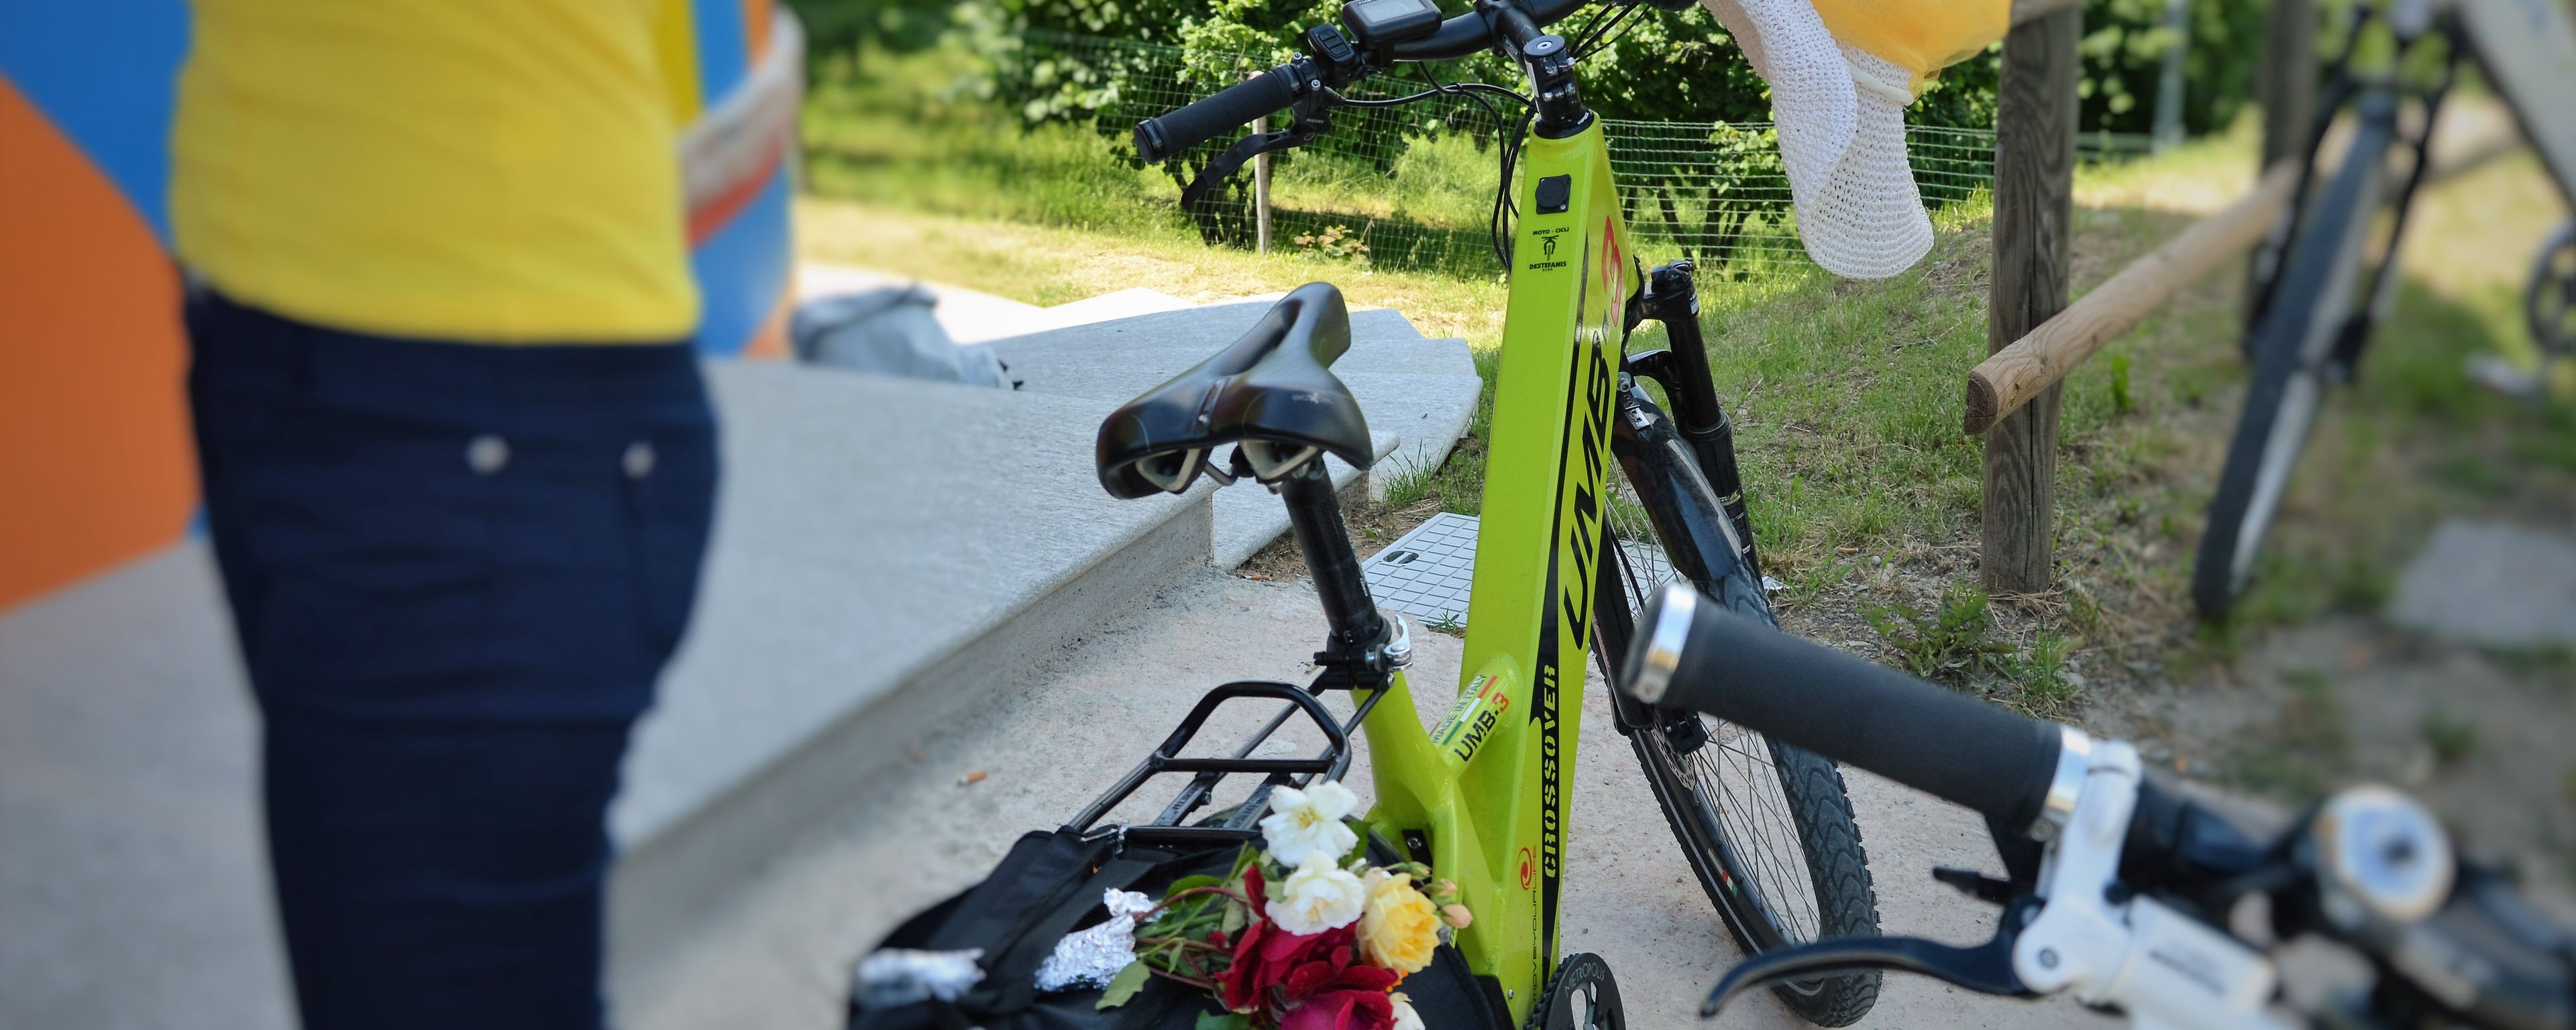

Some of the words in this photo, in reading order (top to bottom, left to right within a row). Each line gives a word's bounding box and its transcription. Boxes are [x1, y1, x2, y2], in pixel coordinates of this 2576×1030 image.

[1529, 261, 1567, 270] DESTEFANIS
[1432, 715, 1458, 744] MADE
[1452, 701, 1468, 712] IN
[1462, 675, 1487, 699] ITALY
[1544, 665, 1556, 878] CROSSOVER
[1564, 962, 1605, 998] METROPOLIS
